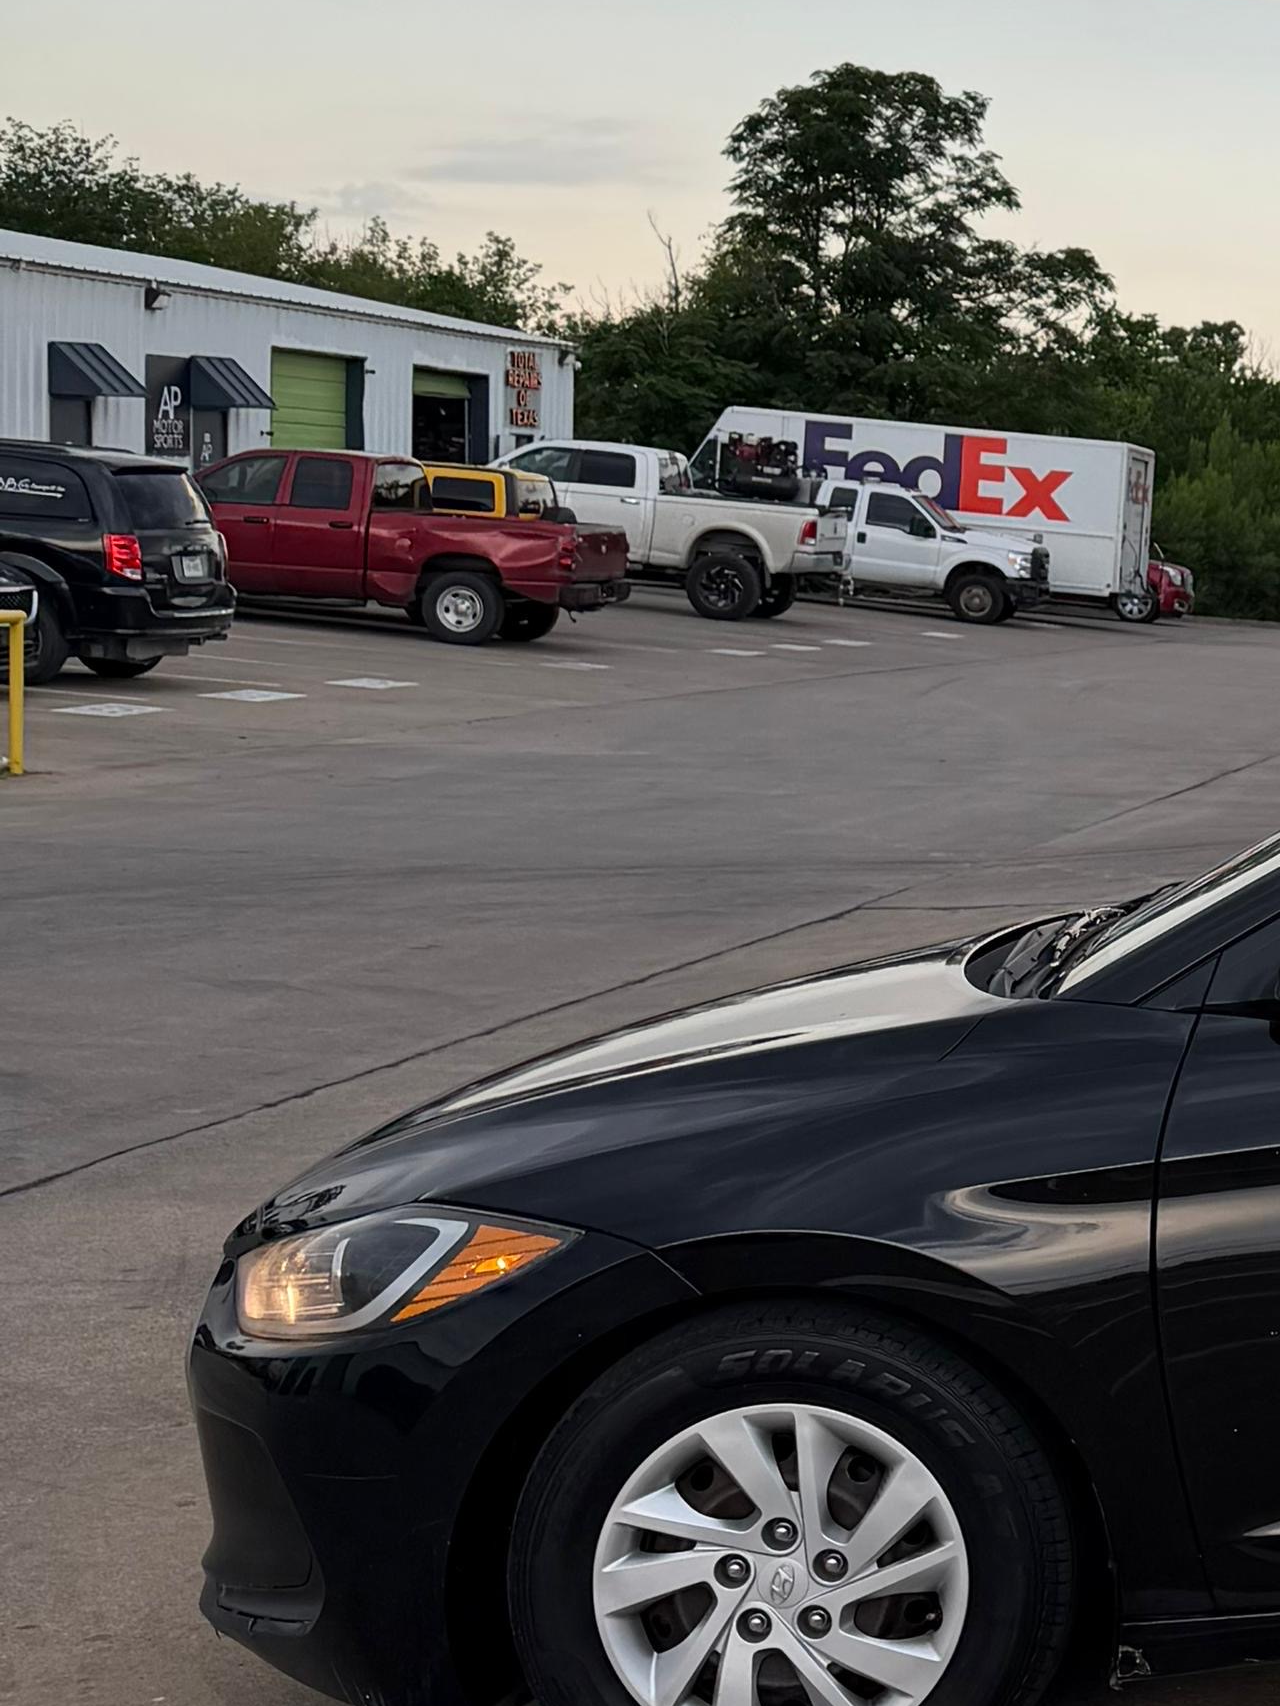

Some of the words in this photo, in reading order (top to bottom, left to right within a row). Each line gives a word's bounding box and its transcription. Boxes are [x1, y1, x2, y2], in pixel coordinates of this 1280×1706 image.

[509, 351, 538, 370] TOTAL
[158, 385, 182, 420] AP
[153, 419, 185, 434] MOTOR
[509, 408, 538, 427] TEXAS
[153, 434, 184, 449] SPORTS
[803, 419, 1074, 523] FedEx
